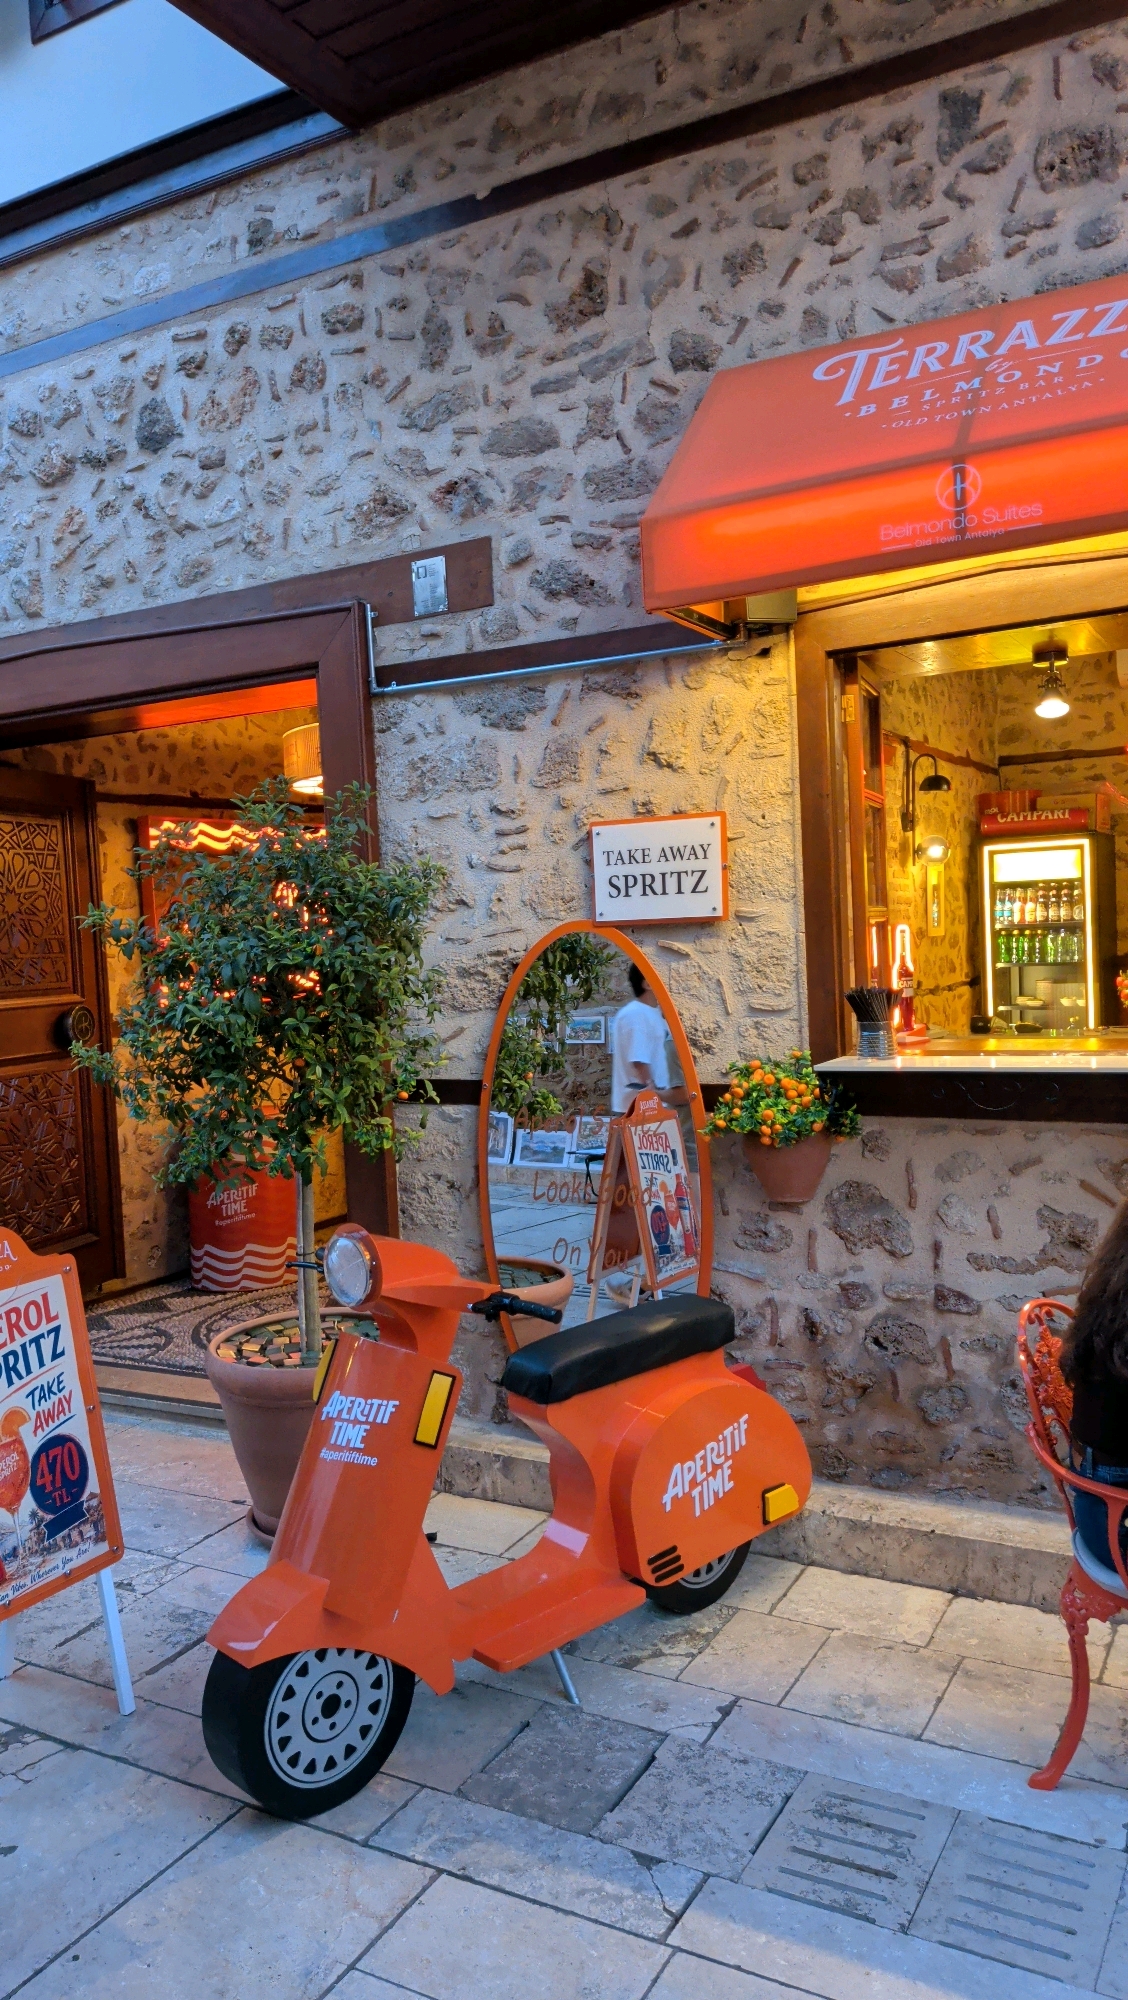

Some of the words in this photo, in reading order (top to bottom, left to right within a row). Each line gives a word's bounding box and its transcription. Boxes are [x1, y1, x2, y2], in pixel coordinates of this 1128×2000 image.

[891, 417, 928, 428] OLD
[934, 405, 992, 422] TOWN
[998, 381, 1093, 410] ANTALYA
[921, 387, 1006, 411] SPRITZ
[1019, 376, 1064, 390] BAR
[880, 513, 978, 541] Belmondo
[982, 503, 1043, 525] Suites
[914, 537, 932, 548] Old
[935, 533, 962, 543] Town
[964, 528, 1005, 540] Antalya
[602, 847, 652, 866] TAKE
[656, 843, 712, 863] AWAY
[608, 869, 709, 899] SPRITZ
[532, 1170, 593, 1204] Looks
[221, 1199, 248, 1217] TIME
[553, 1236, 581, 1265] On
[0, 1324, 65, 1388] RITZ
[25, 1371, 66, 1411] TAKE
[32, 1389, 73, 1438] AWAY
[330, 1421, 371, 1449] TIME
[36, 1441, 81, 1493] 470
[319, 1447, 378, 1467] #aperitiftime
[691, 1459, 735, 1518] TIME
[30, 1563, 60, 1585] Wherever
[61, 1555, 74, 1571] You
